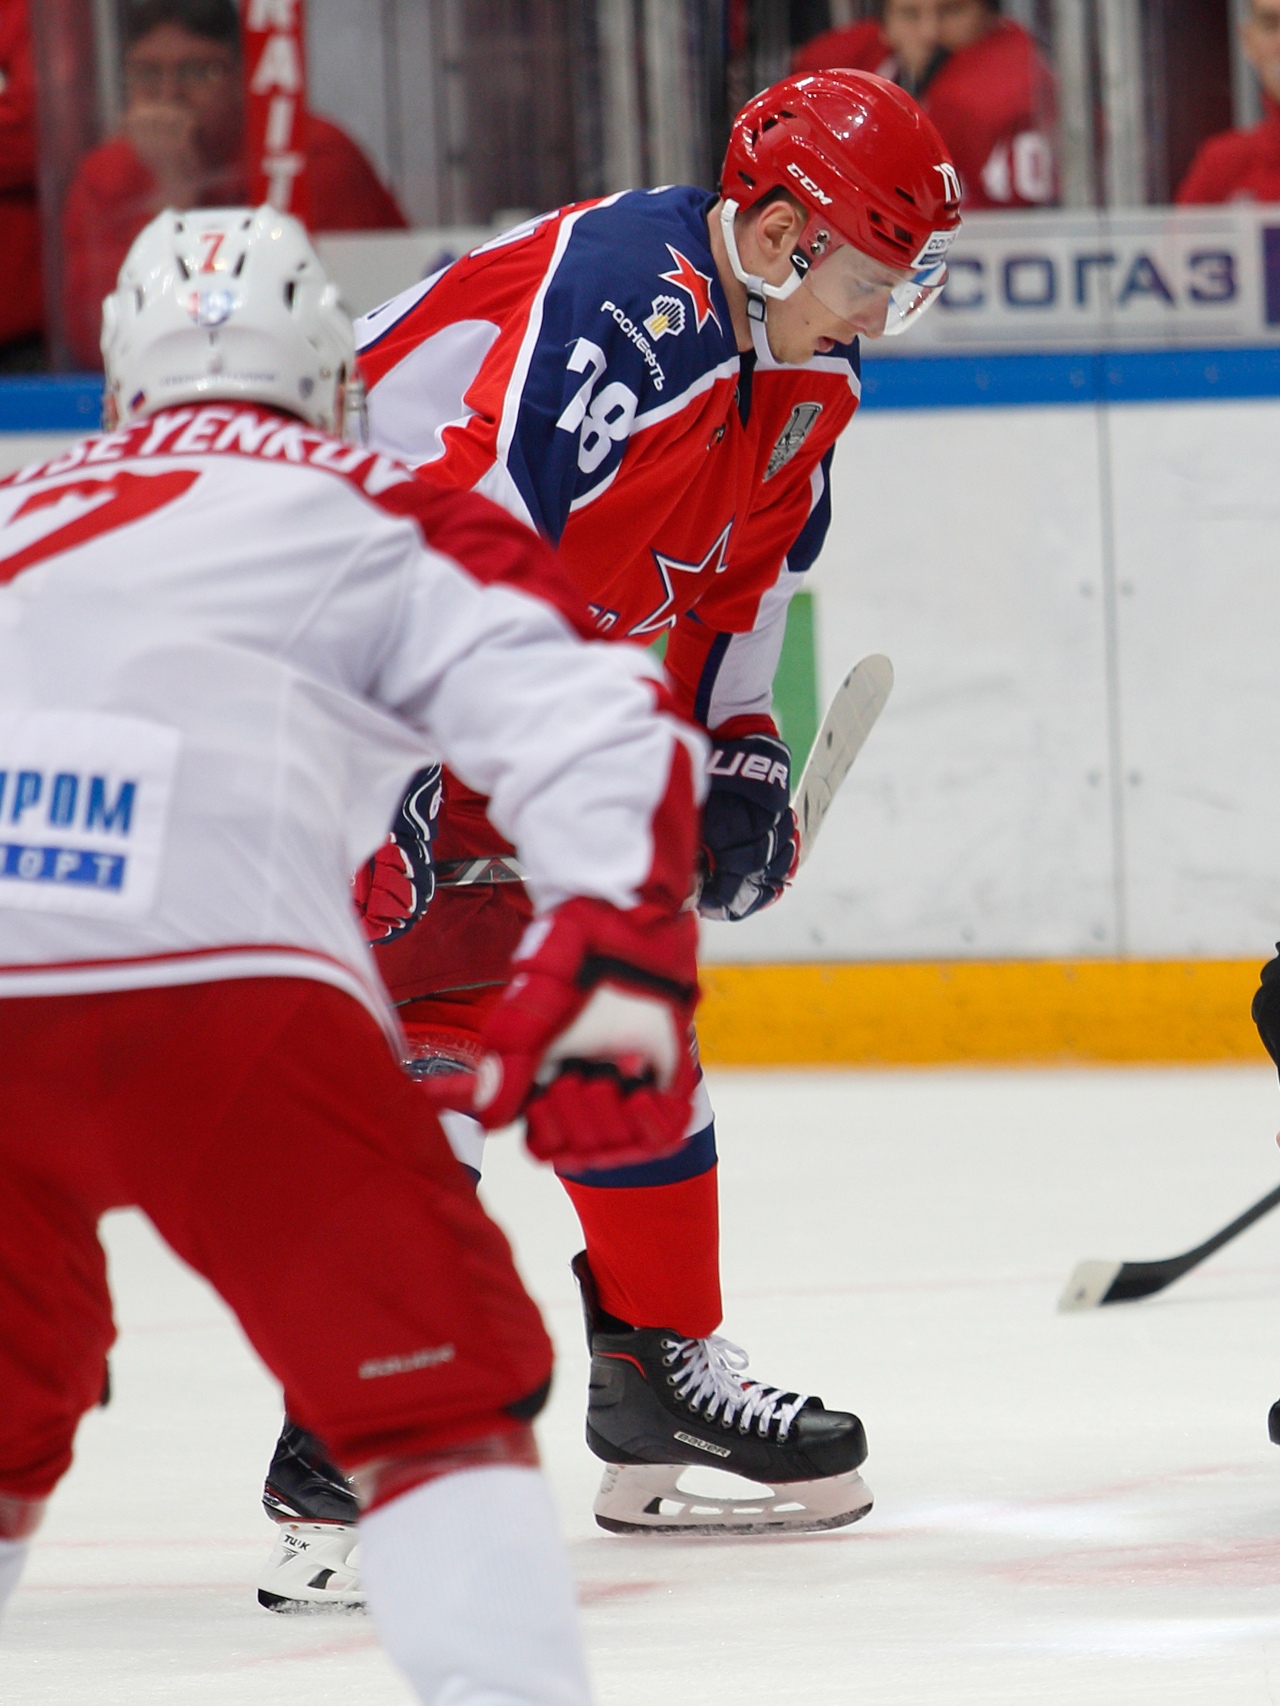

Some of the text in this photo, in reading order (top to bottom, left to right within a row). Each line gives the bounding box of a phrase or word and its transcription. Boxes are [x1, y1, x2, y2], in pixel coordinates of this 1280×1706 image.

[786, 162, 834, 206] CCM
[201, 231, 227, 274] 7
[940, 250, 1238, 309] СОГАЗ
[556, 336, 639, 475] 78
[706, 749, 788, 790] UER
[0, 771, 137, 838] РОМ
[677, 1432, 729, 1457] BAUER
